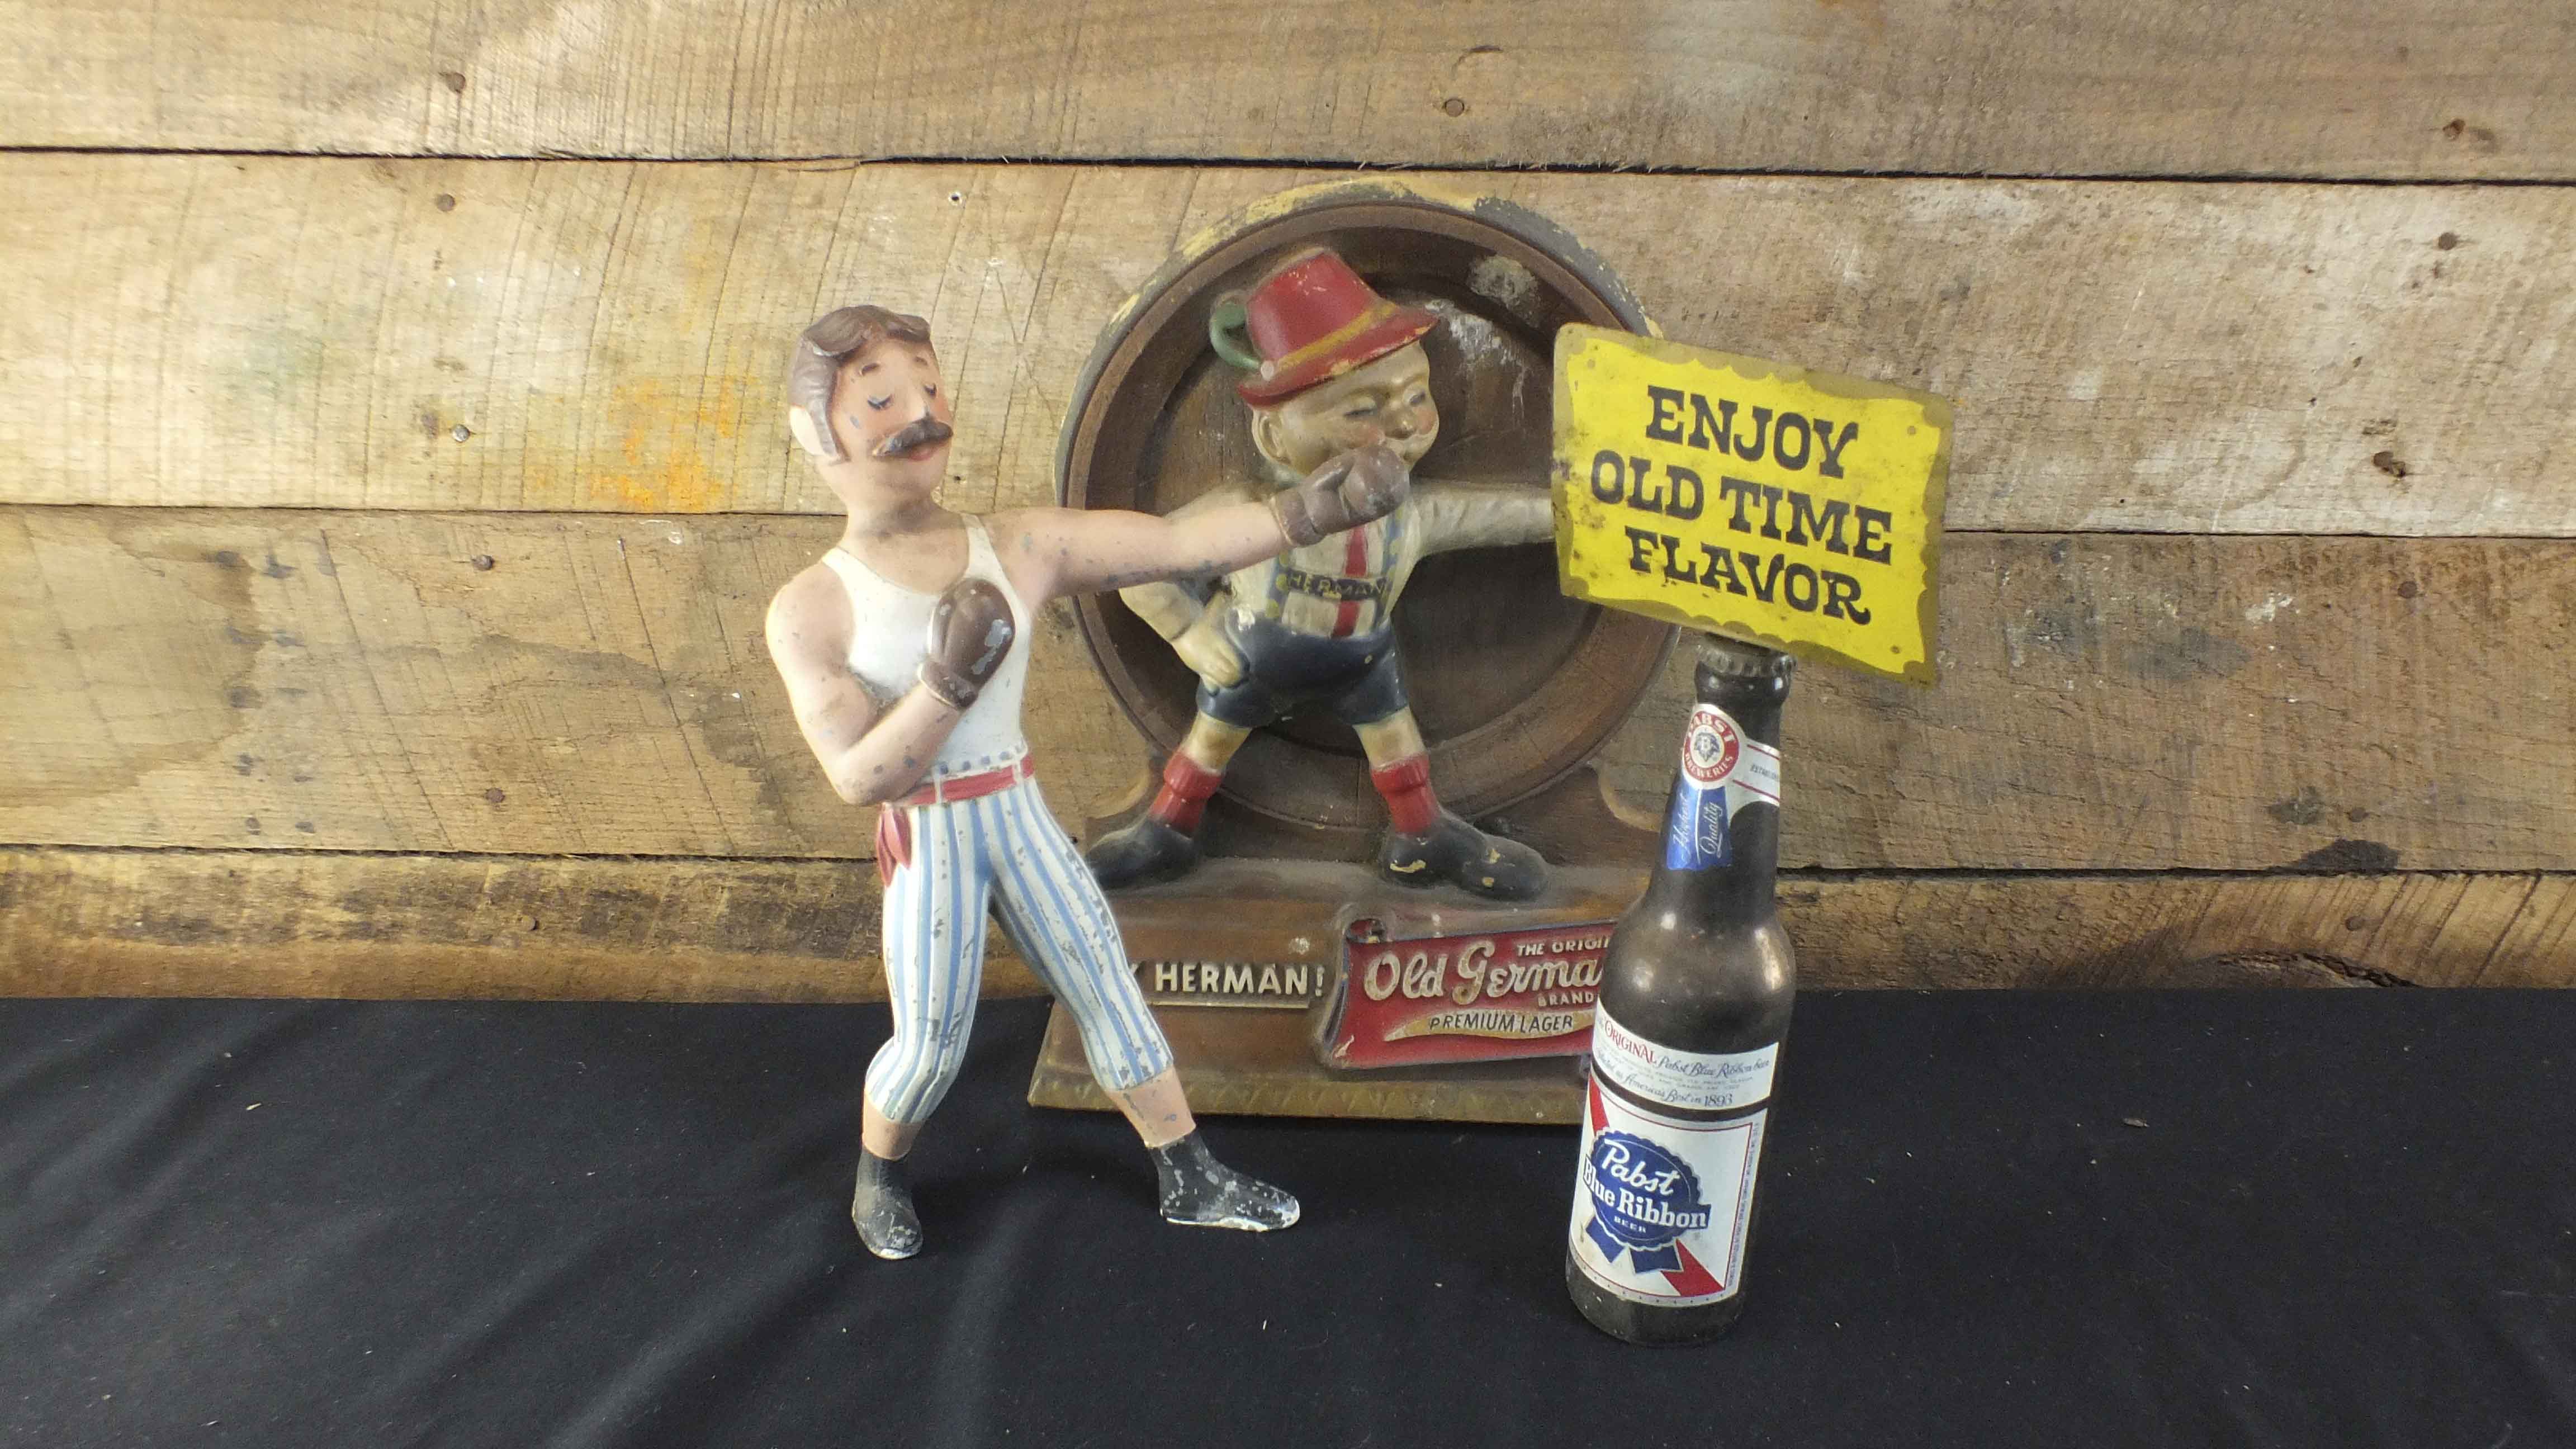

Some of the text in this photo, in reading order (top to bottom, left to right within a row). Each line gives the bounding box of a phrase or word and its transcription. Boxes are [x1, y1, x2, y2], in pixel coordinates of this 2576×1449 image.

[1646, 385, 1858, 479] ENJOY
[1590, 450, 1892, 565] OLD TIME
[1625, 526, 1871, 625] FLAVOR
[1699, 801, 1723, 859] Quality
[1363, 940, 1604, 1005] Old Germa
[1517, 943, 1545, 956] THE
[1155, 963, 1324, 997] HERMAN!
[1538, 992, 1594, 1006] BRAND
[1429, 1014, 1573, 1033] PREMIUM LAGER
[1605, 1020, 1656, 1064] ORIGINAL
[1658, 1055, 1688, 1073] Pabst
[1689, 1062, 1713, 1076] Blue
[1716, 1062, 1751, 1078] Ribbon
[1664, 1089, 1689, 1102] Best
[1704, 1093, 1734, 1107] 1893
[1583, 1158, 1708, 1228] Blue Ribbon
[1602, 1138, 1680, 1196] Pabst
[1614, 1215, 1646, 1233] BEER
